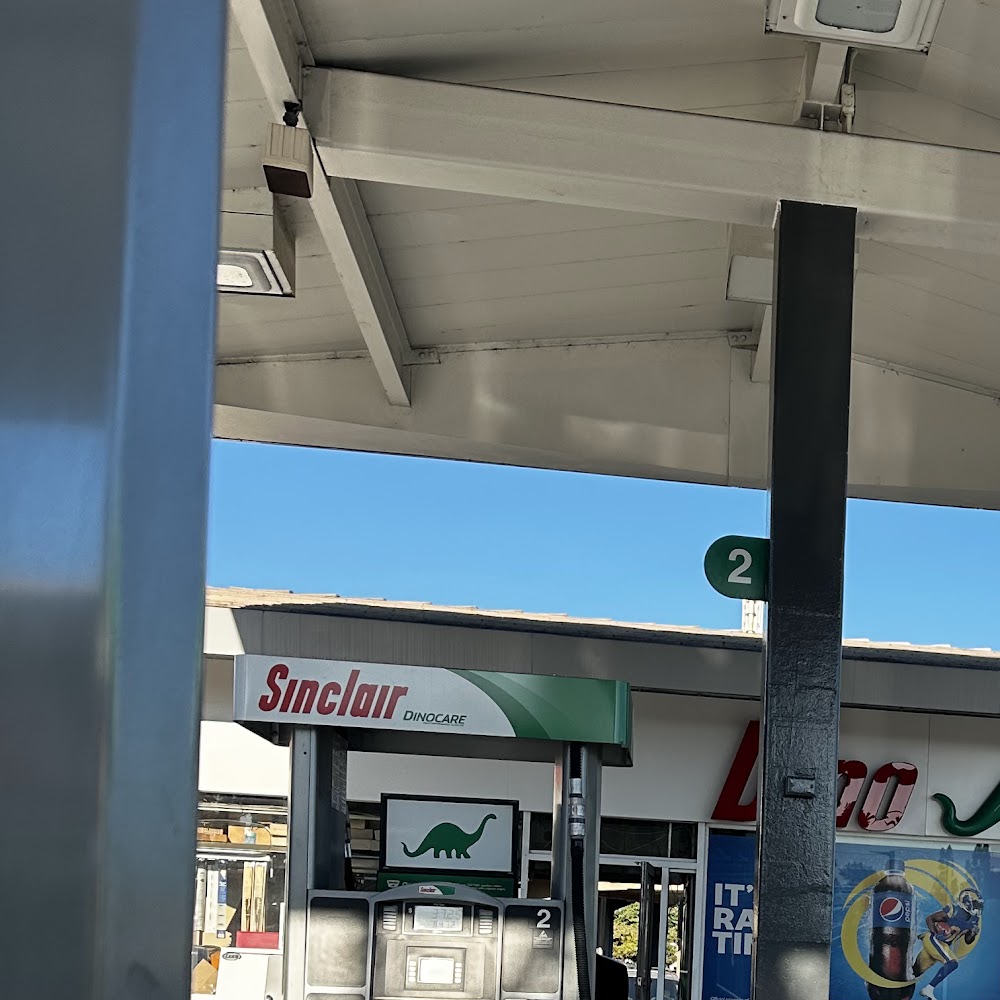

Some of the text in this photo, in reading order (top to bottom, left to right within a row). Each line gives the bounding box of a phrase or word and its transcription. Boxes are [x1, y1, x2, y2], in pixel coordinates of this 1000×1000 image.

[728, 548, 752, 584] 2
[258, 664, 408, 719] Sinclair
[714, 883, 754, 906] IT'
[537, 908, 551, 928] 2
